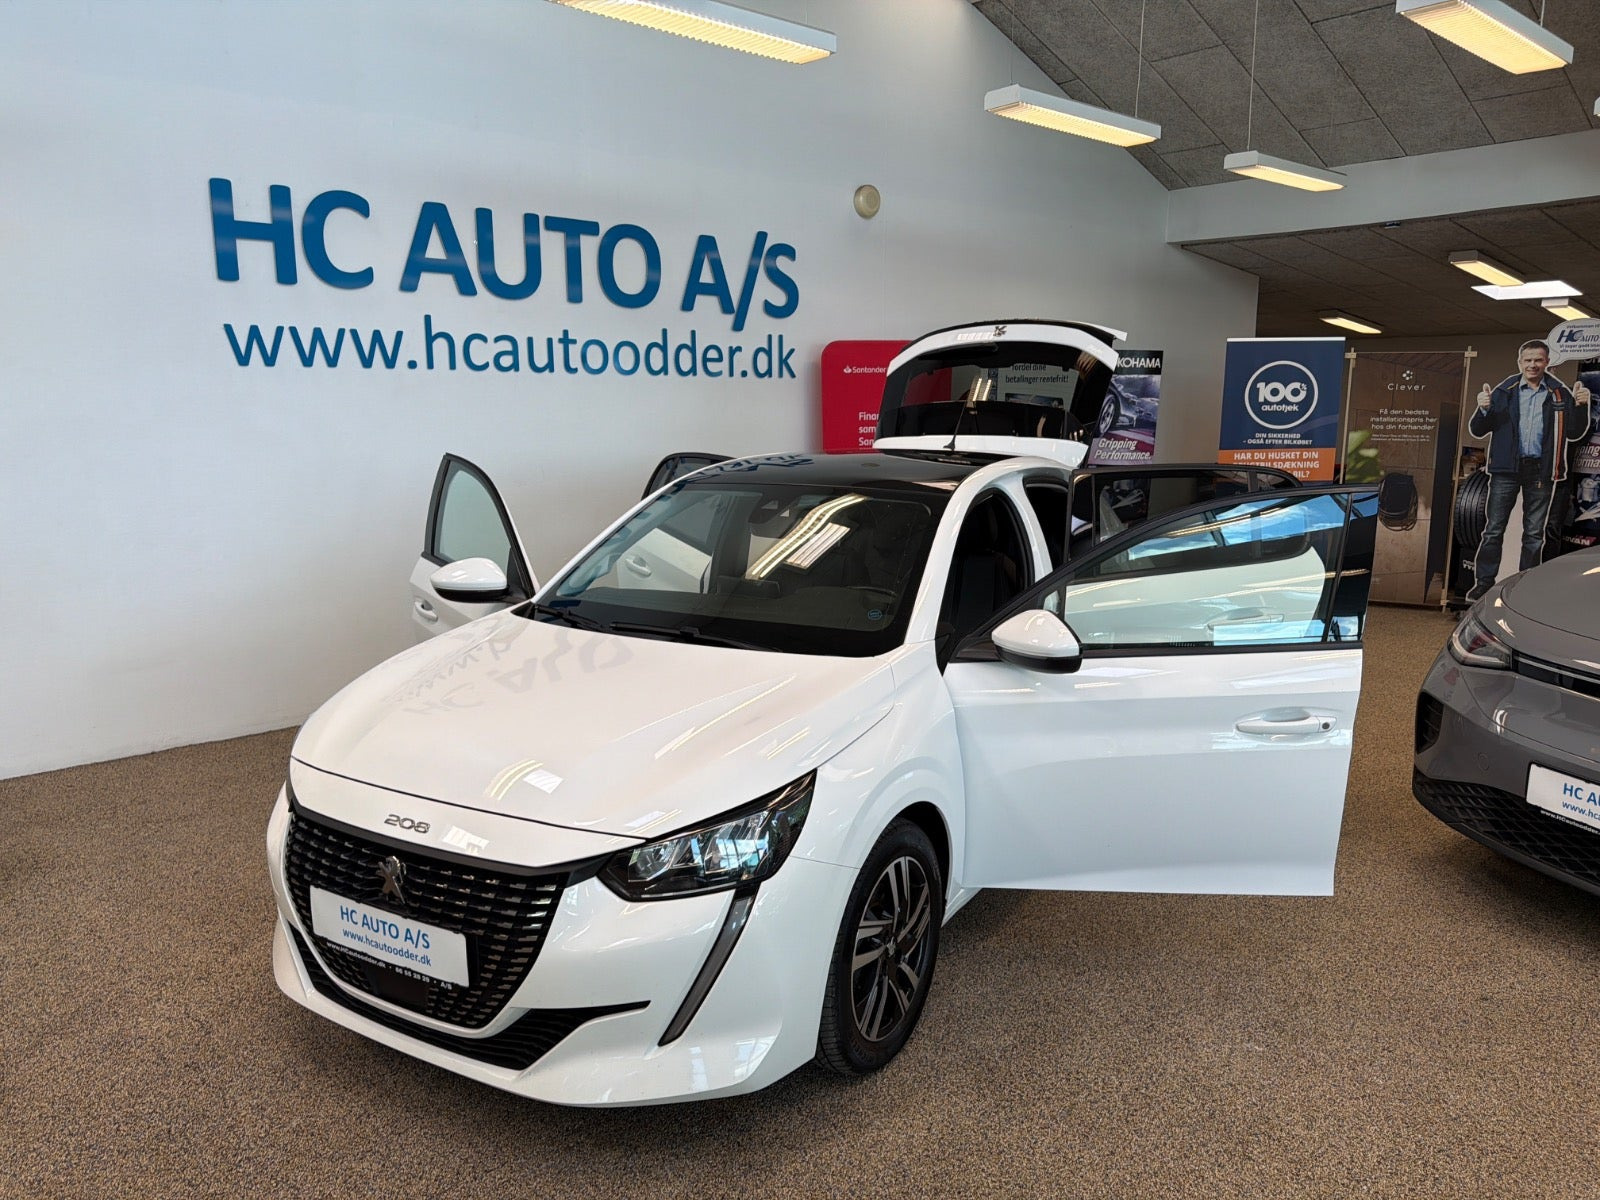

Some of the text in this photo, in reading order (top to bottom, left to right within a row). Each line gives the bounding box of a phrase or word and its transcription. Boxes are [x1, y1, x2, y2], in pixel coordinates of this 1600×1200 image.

[208, 177, 800, 332] HC AUTO A/S
[1557, 330, 1584, 343] HC
[223, 314, 797, 380] www.hcautoodder.dk
[1117, 357, 1161, 369] KOHAMA
[852, 366, 887, 374] Santander
[1005, 374, 1040, 385] betalinger
[1387, 383, 1427, 391] Clever
[1261, 404, 1299, 413] autotjek
[1098, 438, 1137, 450] Gripping
[1094, 449, 1152, 461] Performance.
[1268, 452, 1300, 460] HUSKET
[1302, 451, 1319, 459] DIN
[1563, 782, 1584, 800] HC
[384, 814, 430, 834] 208
[340, 905, 430, 949] HC AUTO A/S
[342, 928, 431, 966] www.hcautoodder.dk
